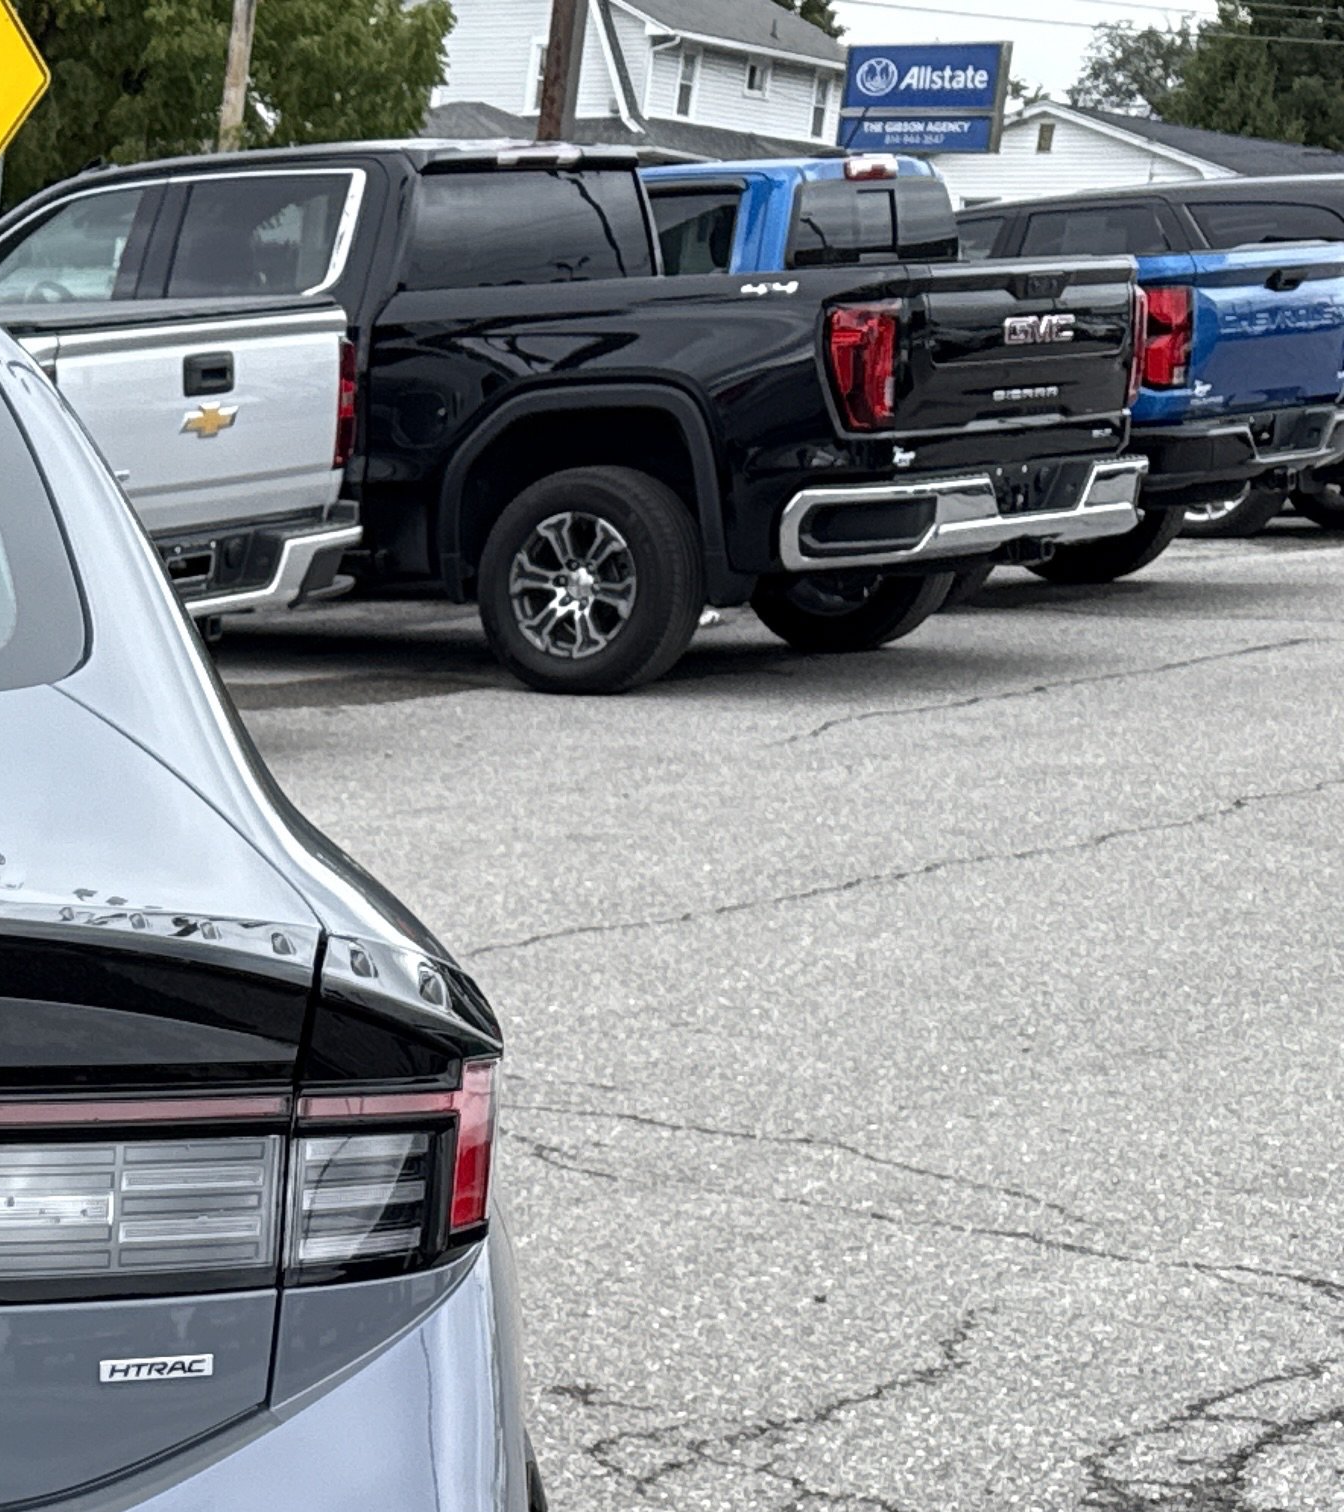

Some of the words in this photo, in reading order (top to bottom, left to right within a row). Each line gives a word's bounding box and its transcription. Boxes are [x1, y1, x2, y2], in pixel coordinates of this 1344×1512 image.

[898, 65, 989, 90] Allstate
[927, 121, 972, 133] AGENCY
[1004, 314, 1075, 344] GMC
[993, 386, 1059, 401] SIERRA
[108, 1358, 207, 1379] HTRAC
